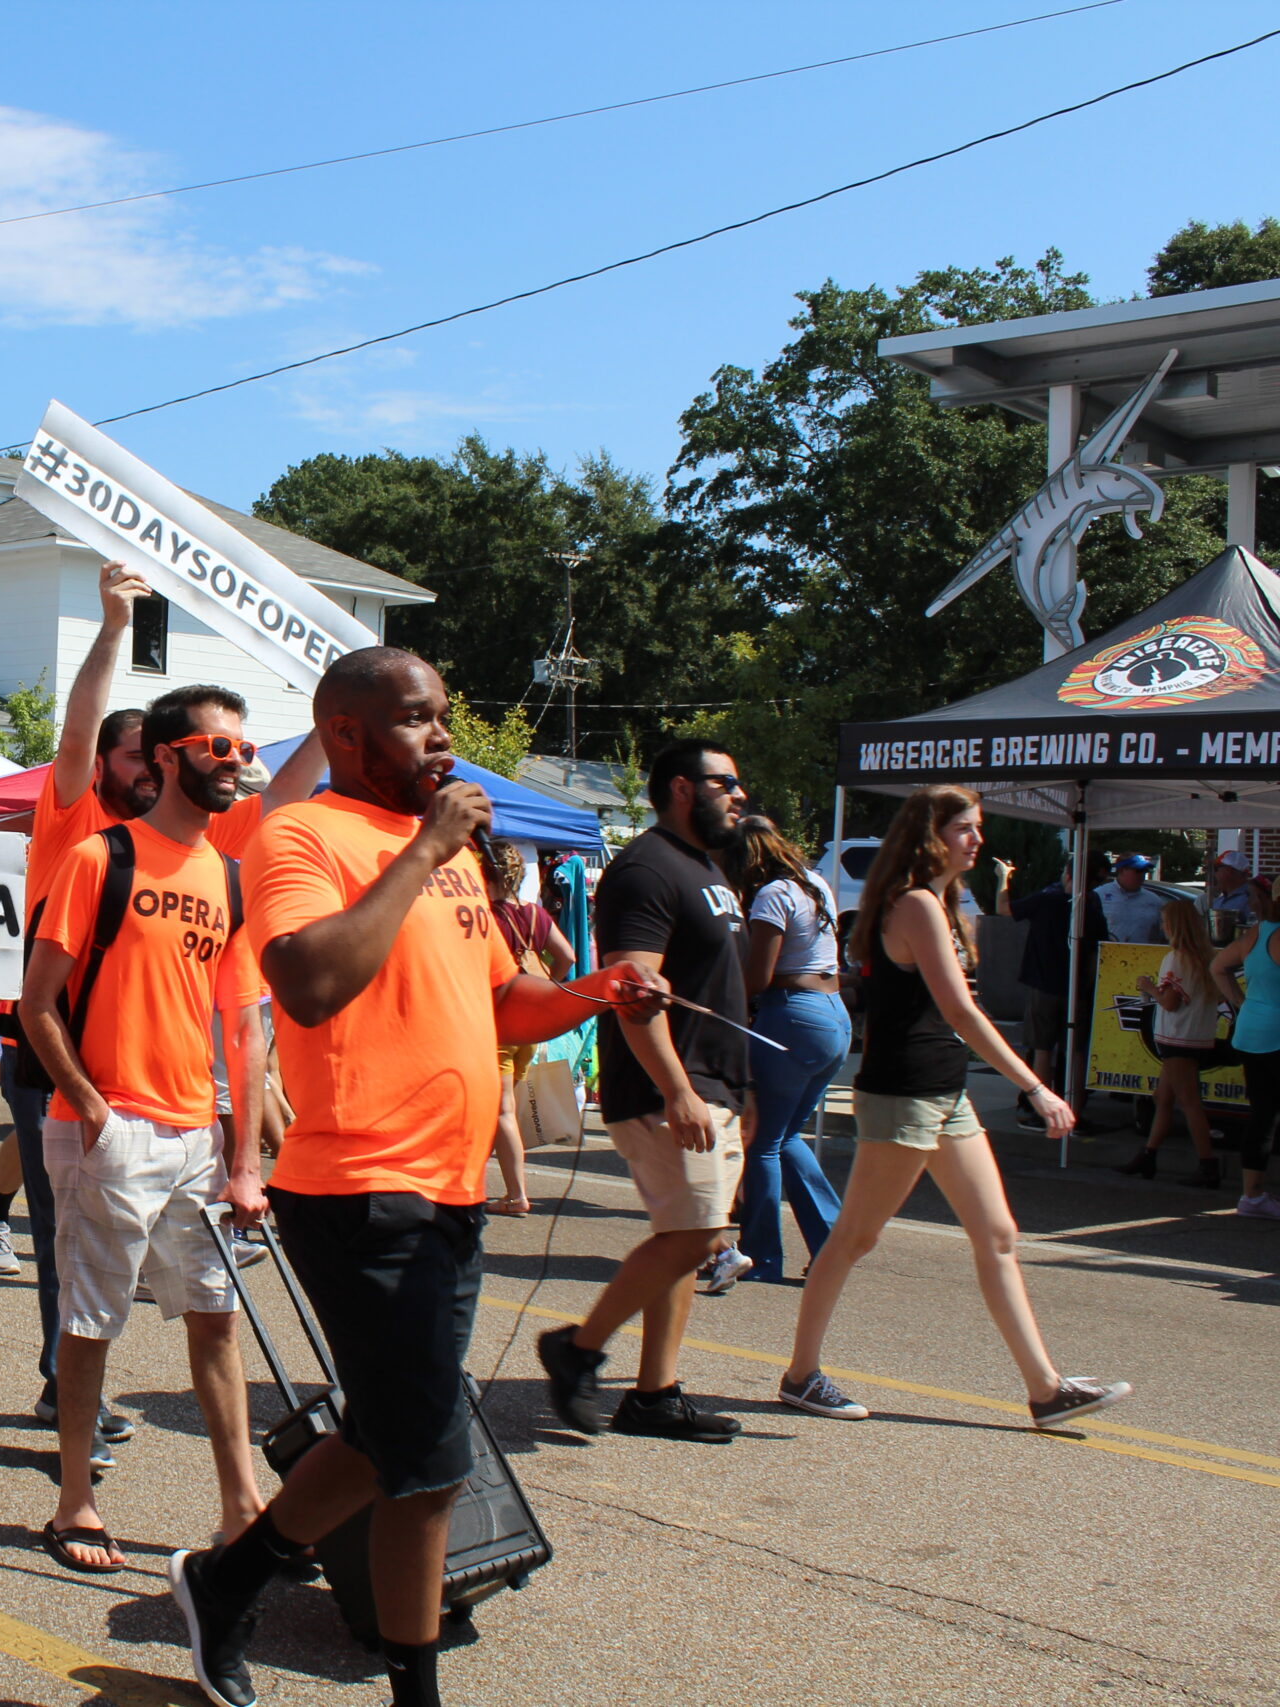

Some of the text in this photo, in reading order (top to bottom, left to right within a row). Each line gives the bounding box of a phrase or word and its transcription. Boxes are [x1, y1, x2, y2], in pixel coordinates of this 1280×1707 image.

[29, 439, 344, 671] #30DAYSOFOPE
[1113, 635, 1221, 668] WISEACRE
[859, 738, 984, 771] WISEACRE
[990, 732, 1110, 767] BREWING
[1118, 732, 1165, 765] CO.
[418, 867, 486, 899] PERA
[132, 888, 225, 937] OPERA
[456, 904, 489, 939] 90
[183, 930, 223, 963] 901
[1096, 1071, 1142, 1089] THANK
